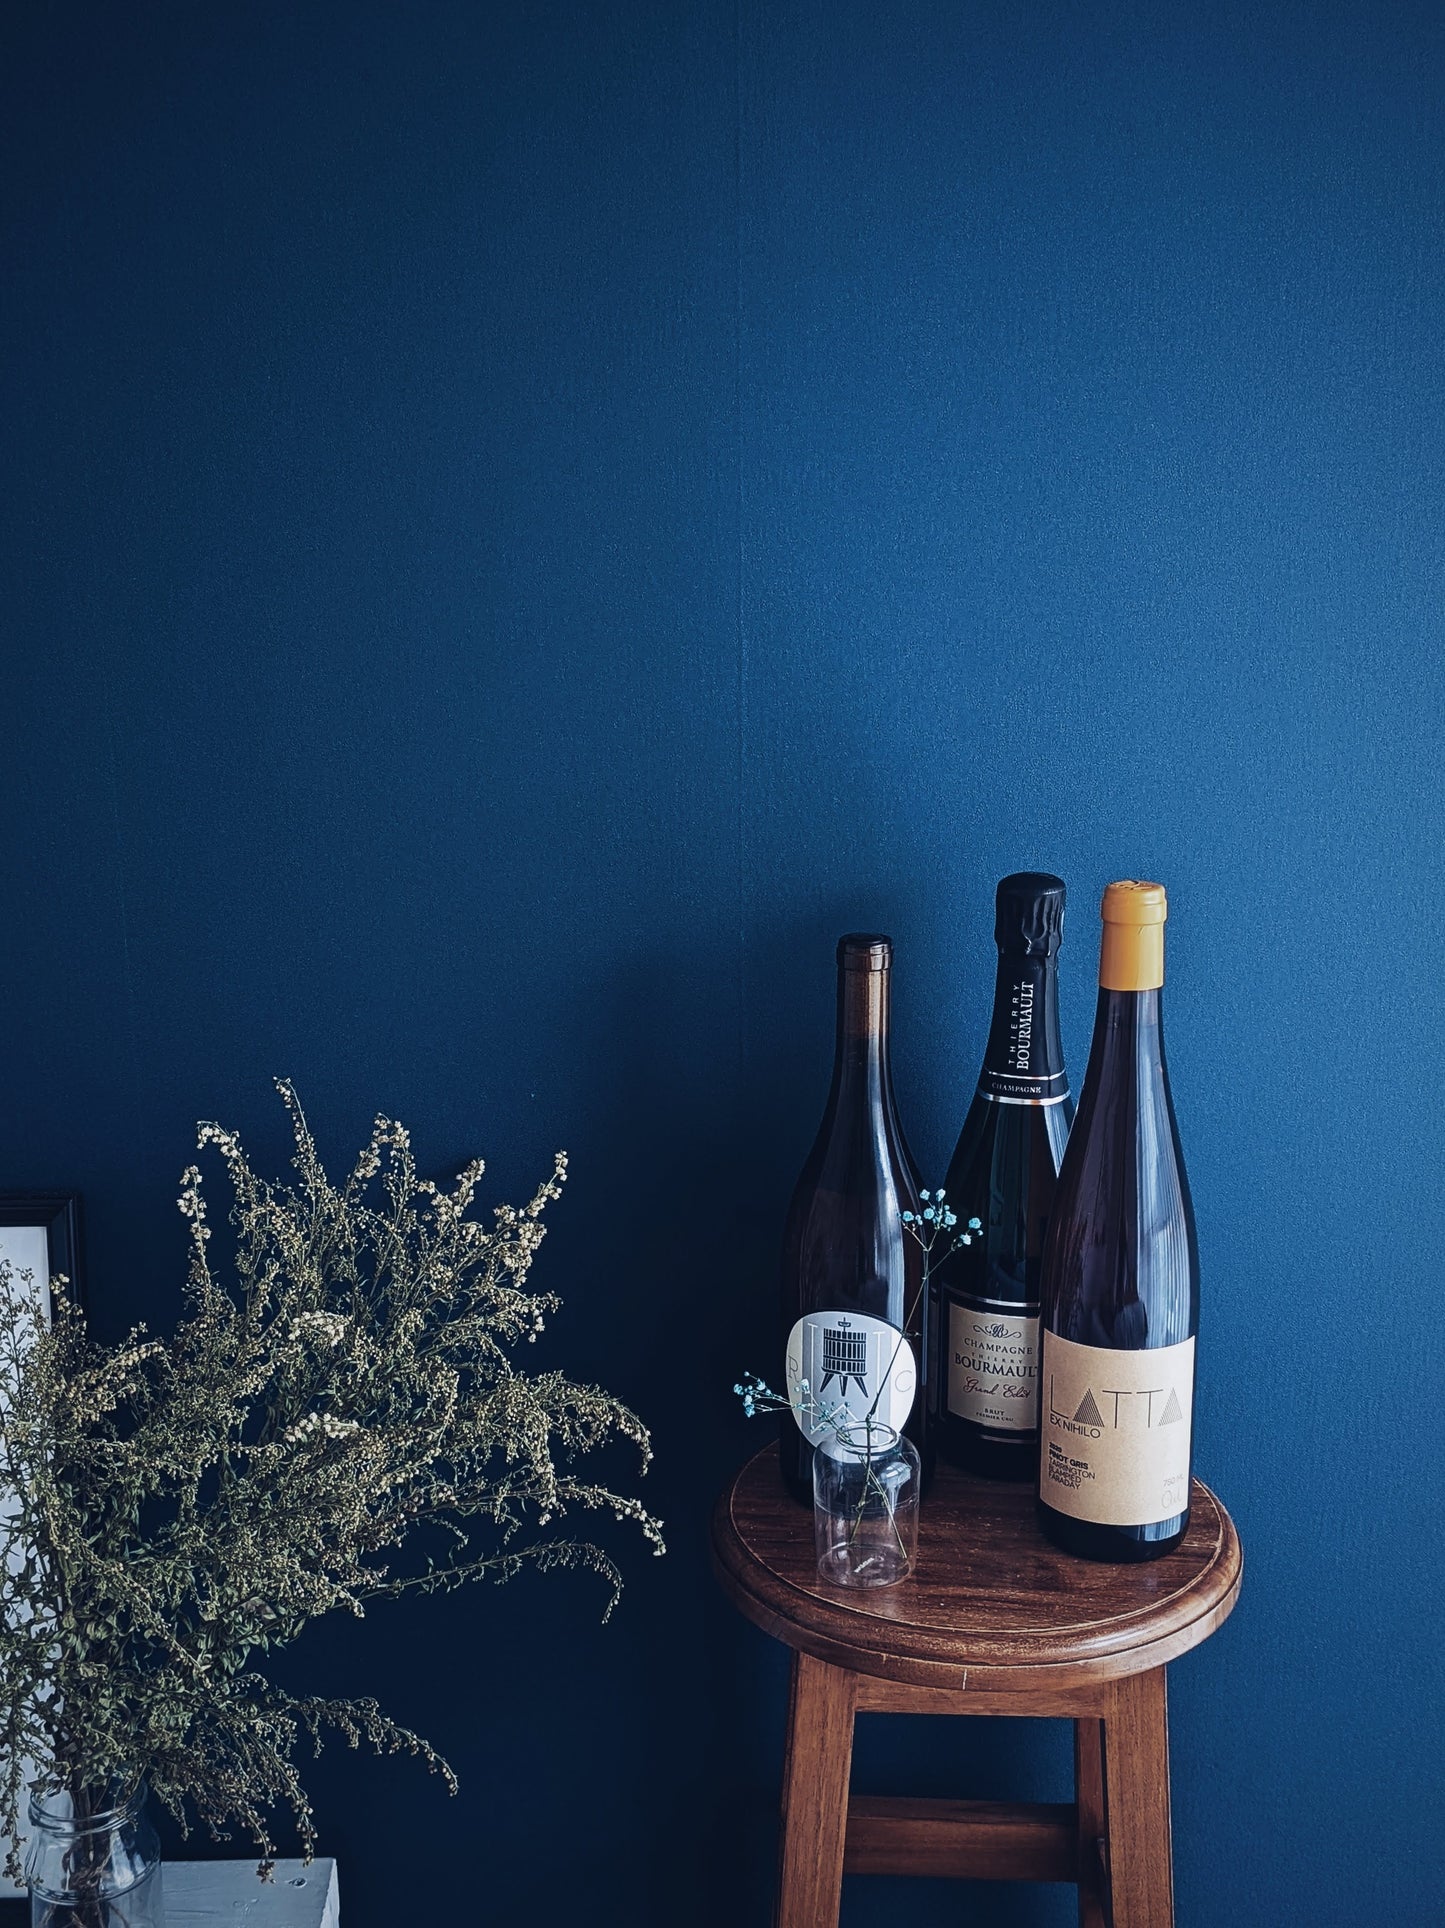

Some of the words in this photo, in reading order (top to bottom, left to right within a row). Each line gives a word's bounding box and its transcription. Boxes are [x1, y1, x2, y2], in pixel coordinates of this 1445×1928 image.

[1008, 984, 1020, 1065] THIERRY
[1016, 981, 1034, 1070] BOURMAULT
[991, 1081, 1042, 1094] CHAMPAGNE
[964, 1337, 1033, 1355] CHAMPAGNE
[971, 1352, 1023, 1364] THIERRY
[962, 1376, 1000, 1395] Grand
[984, 1407, 1006, 1417] BRUT
[1050, 1373, 1184, 1430] LATTA
[1050, 1413, 1062, 1428] EX
[1063, 1421, 1101, 1439] NIHILO
[1048, 1448, 1069, 1464] PINOT
[1069, 1458, 1089, 1470] GRIS
[1048, 1456, 1096, 1480] TARRINGTON
[1048, 1470, 1081, 1490] FARADAY
